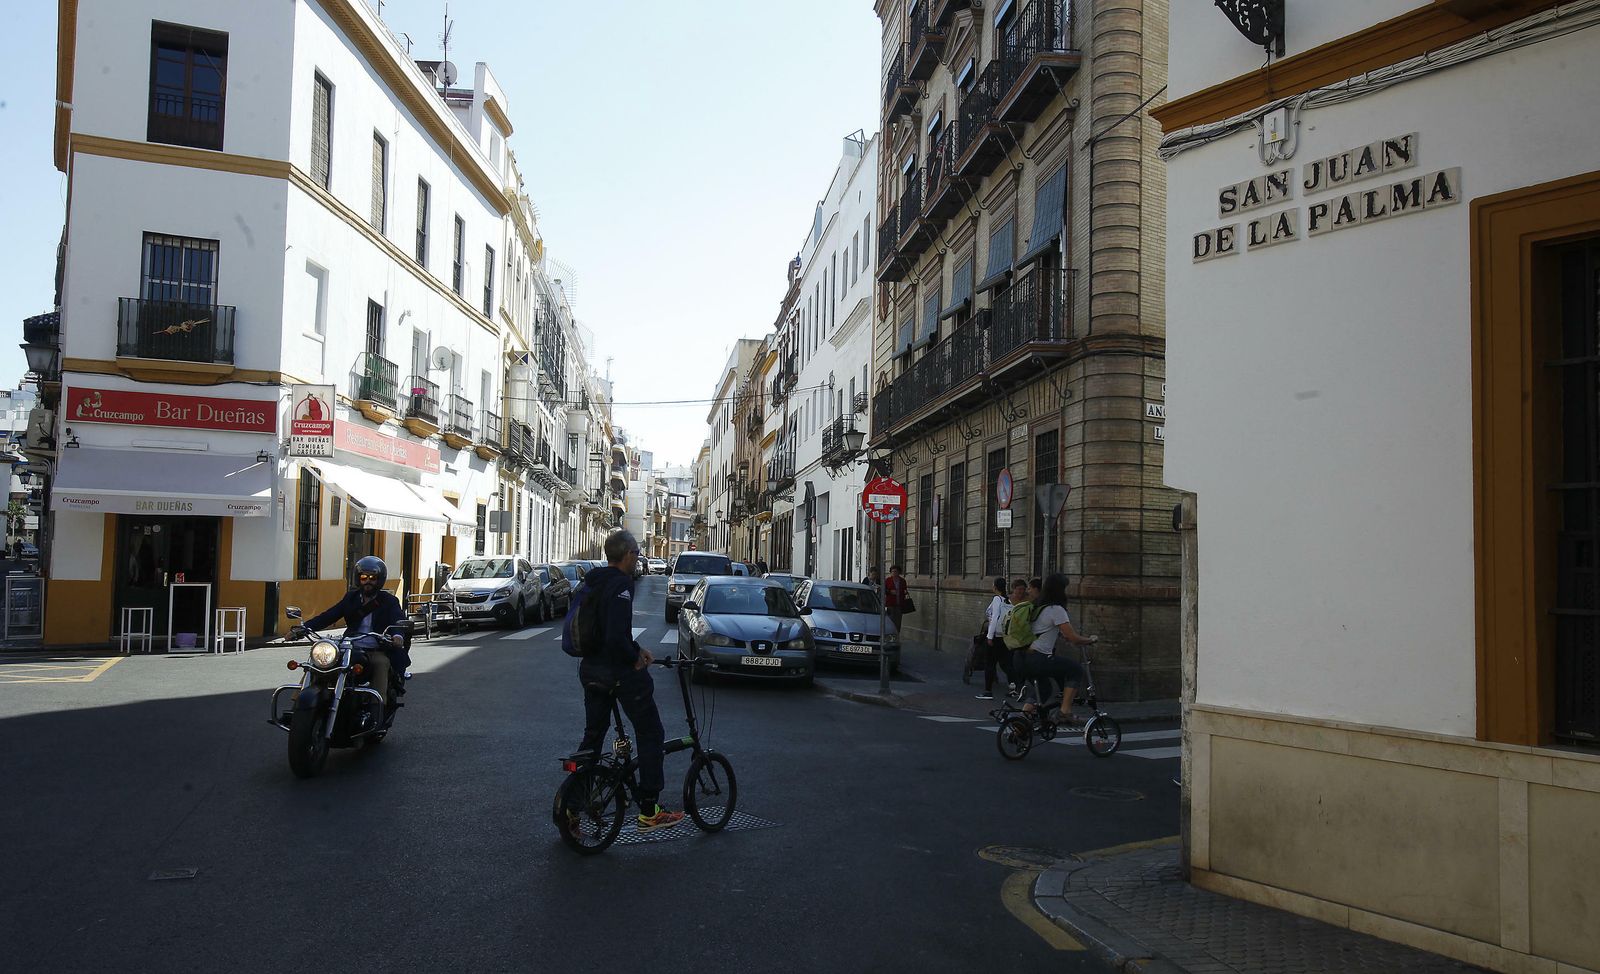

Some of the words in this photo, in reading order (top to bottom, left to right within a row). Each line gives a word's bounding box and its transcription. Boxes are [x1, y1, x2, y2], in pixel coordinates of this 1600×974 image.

[1218, 170, 1288, 214] SAN
[1303, 135, 1412, 190] JUAN
[1193, 227, 1234, 259] DE
[1248, 211, 1293, 247] LA
[1308, 171, 1453, 231] PALMA
[94, 408, 144, 422] Cruzcampo
[156, 400, 192, 420] Bar
[197, 403, 266, 425] Dueñas
[1148, 405, 1165, 417] AN
[294, 421, 331, 431] Cruzcampo
[62, 496, 100, 506] Cruzcampo
[135, 500, 155, 510] BAR
[157, 500, 193, 512] DUEÑAS
[227, 503, 262, 512] Cruzcampo
[745, 656, 764, 665] 8882
